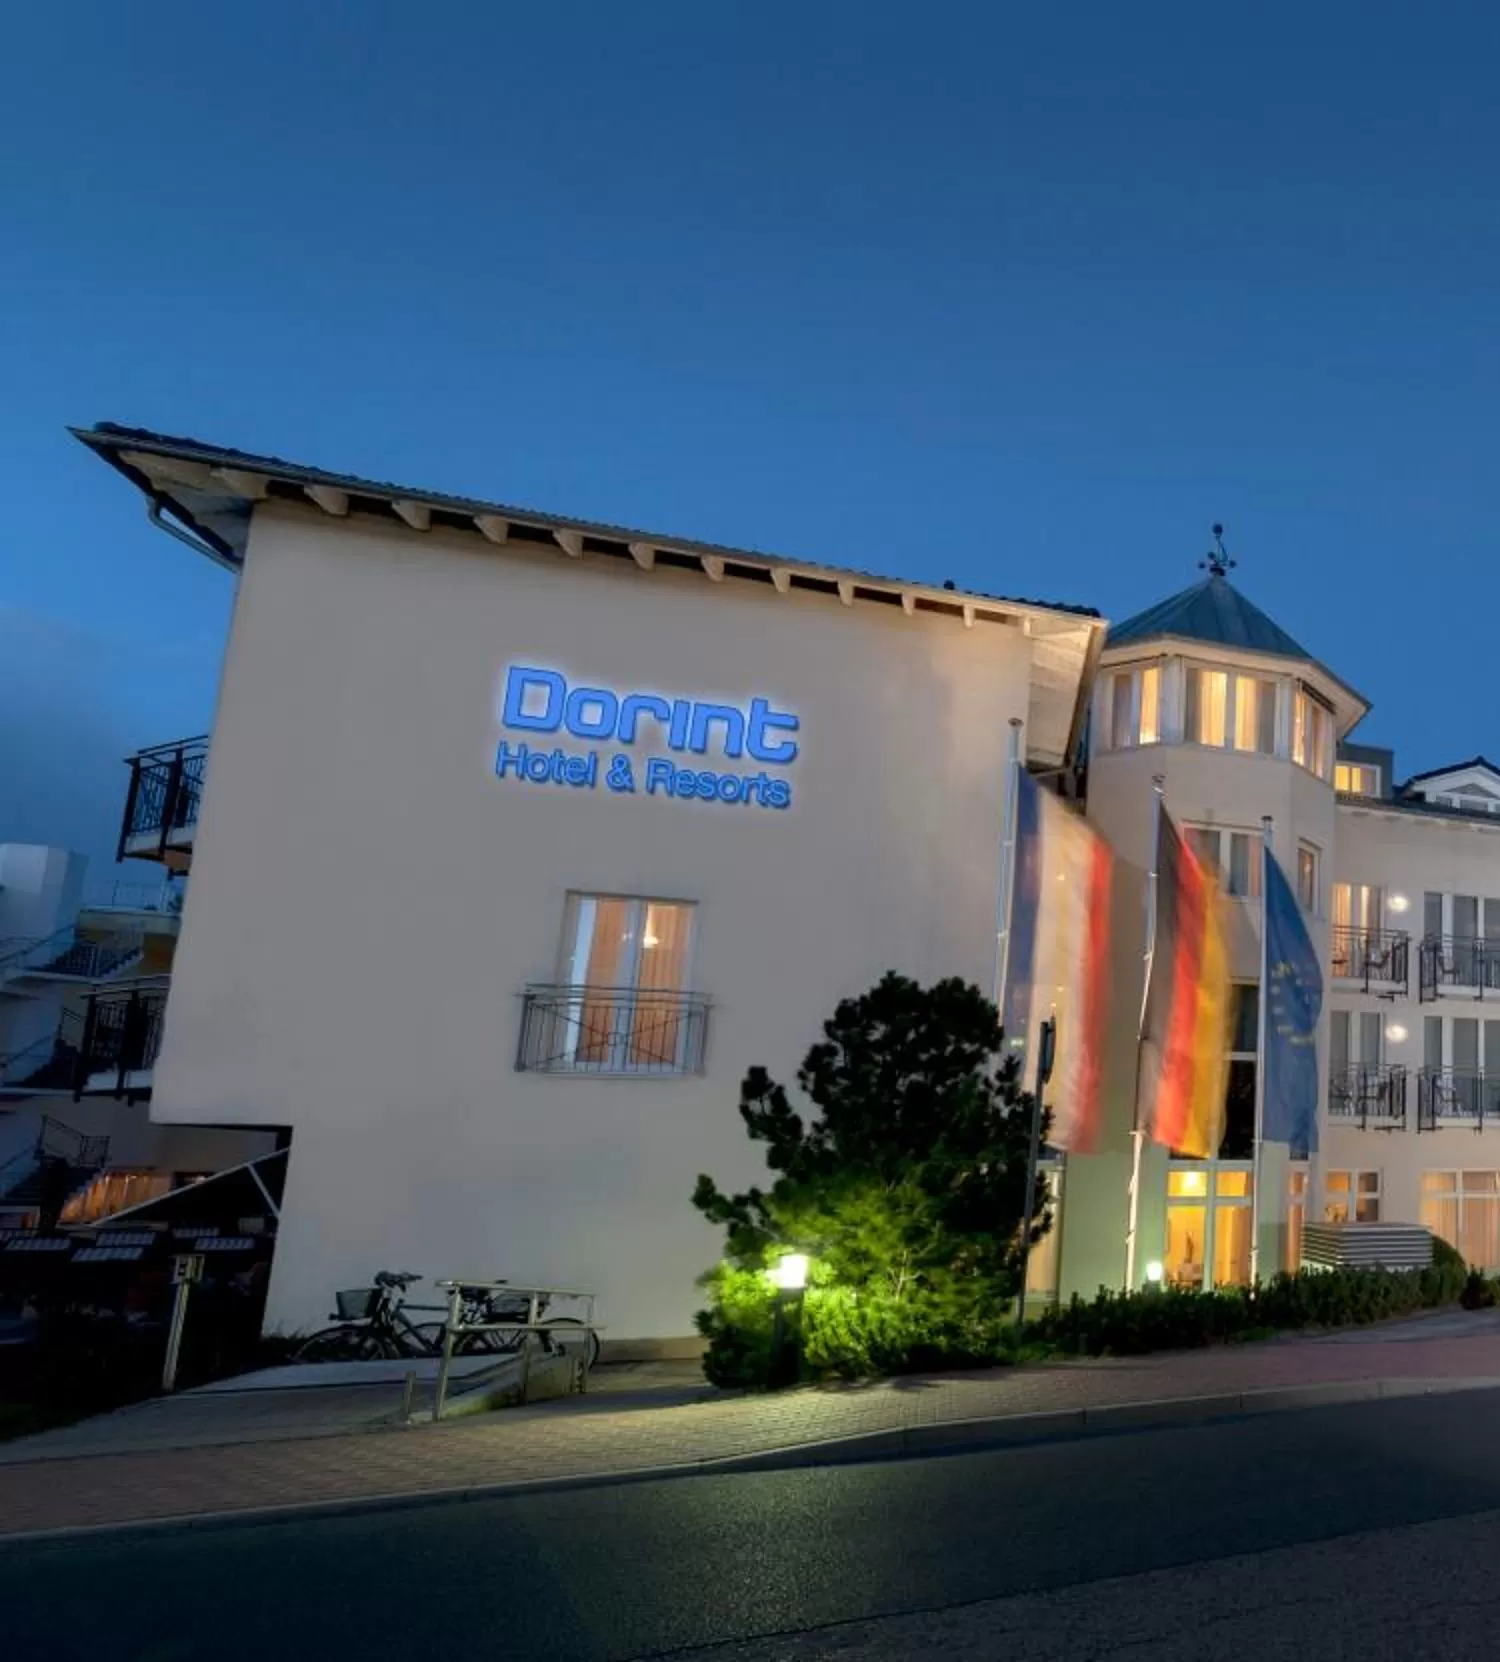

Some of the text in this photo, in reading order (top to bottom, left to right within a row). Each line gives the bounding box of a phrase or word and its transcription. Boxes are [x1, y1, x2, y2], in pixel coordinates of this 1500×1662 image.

[502, 665, 799, 763] Dorint
[496, 741, 791, 809] Hotel & Resorts
